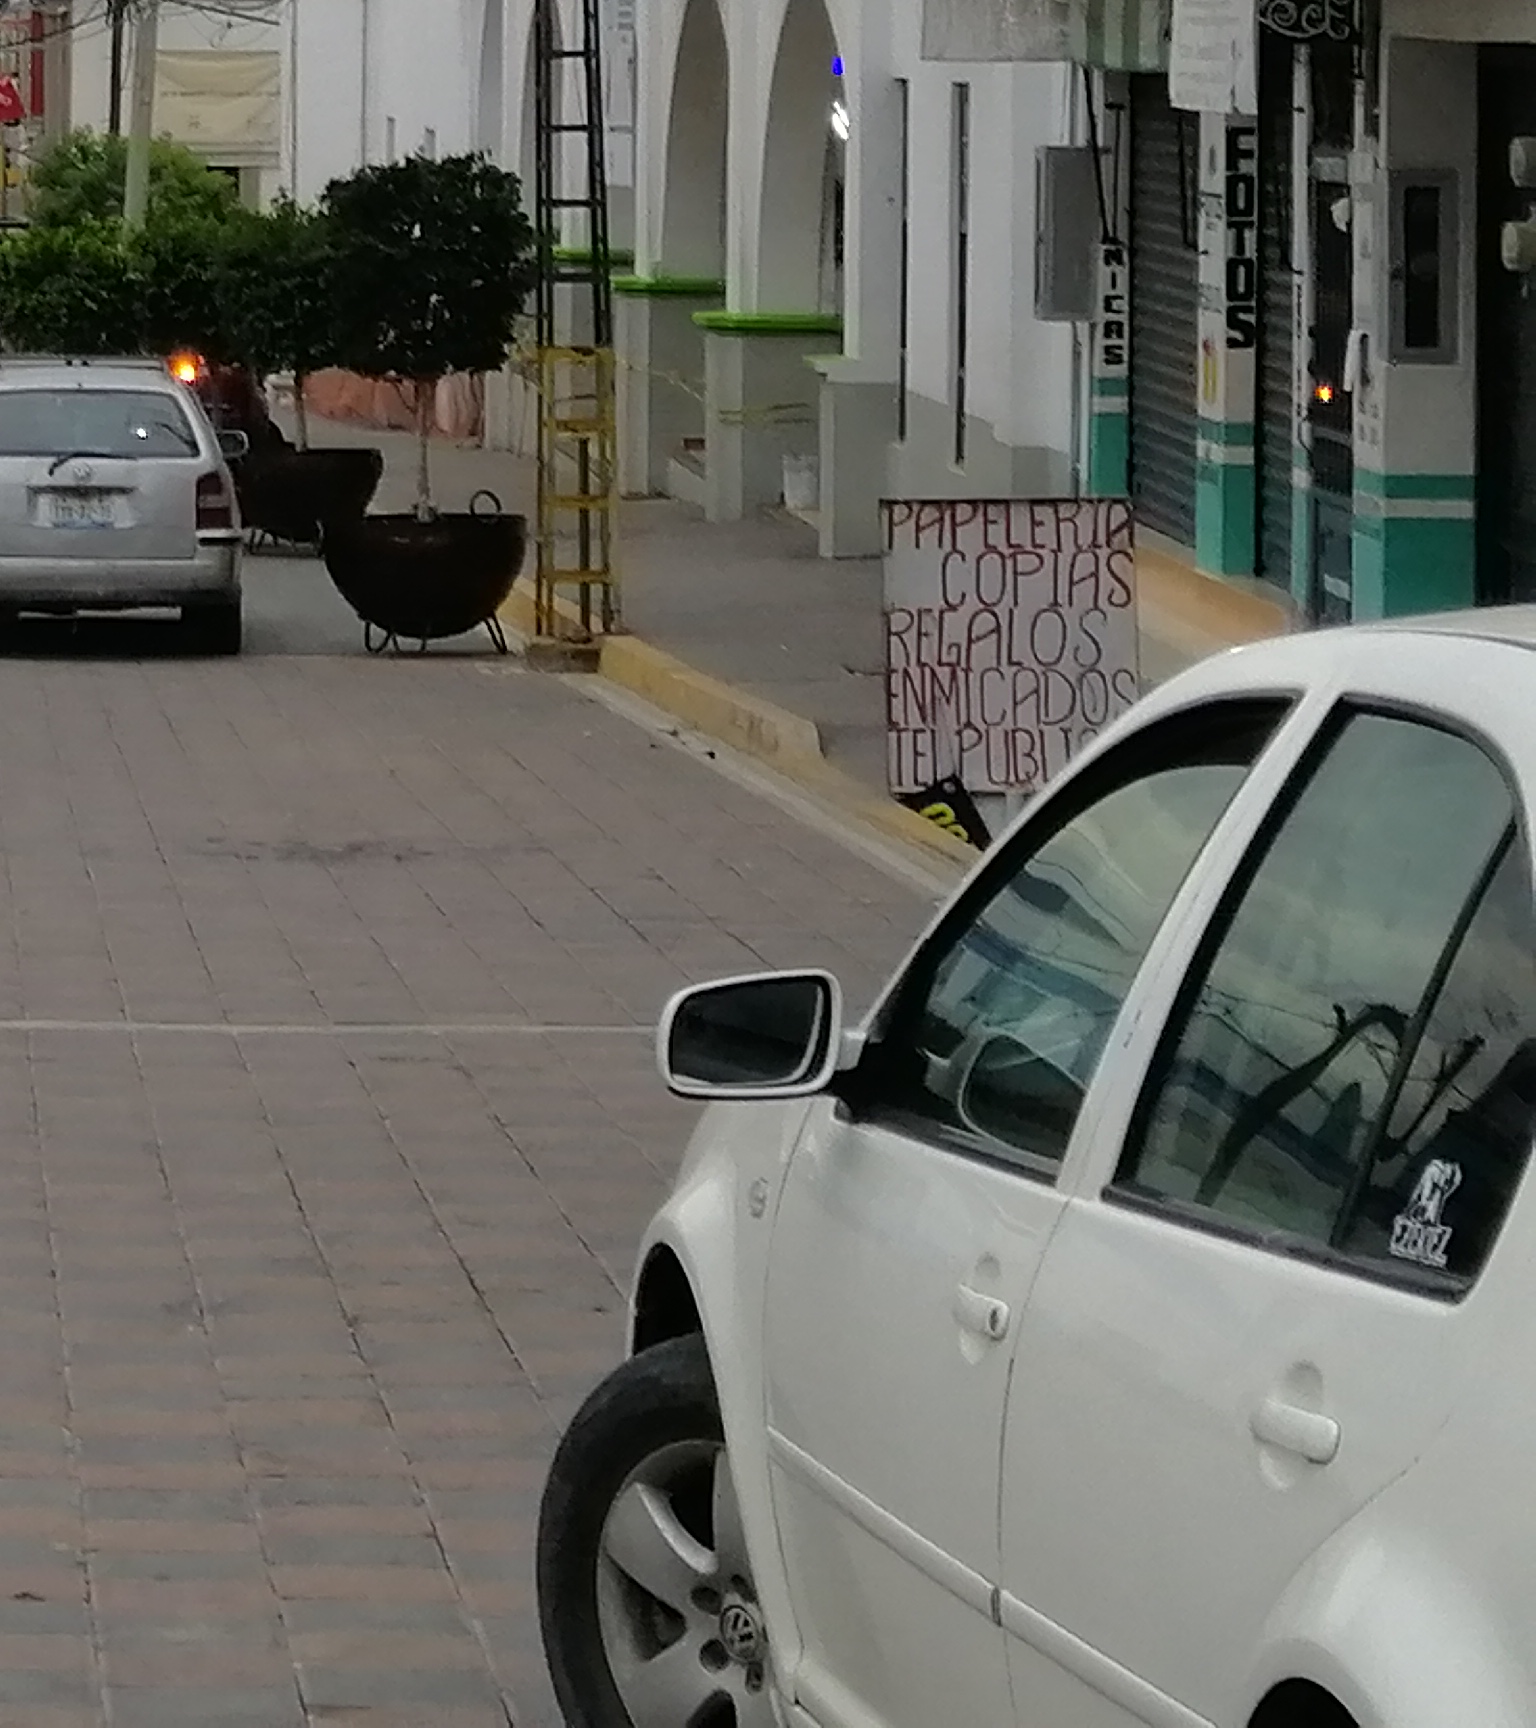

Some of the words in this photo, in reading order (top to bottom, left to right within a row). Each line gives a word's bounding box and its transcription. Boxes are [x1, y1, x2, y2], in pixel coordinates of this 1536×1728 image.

[1225, 127, 1255, 349] FOTOS
[884, 500, 1135, 551] PAPELERIA
[941, 550, 1135, 609] COPIAS
[885, 607, 1108, 669] REGALOS
[886, 668, 1135, 727] ENMICADOS
